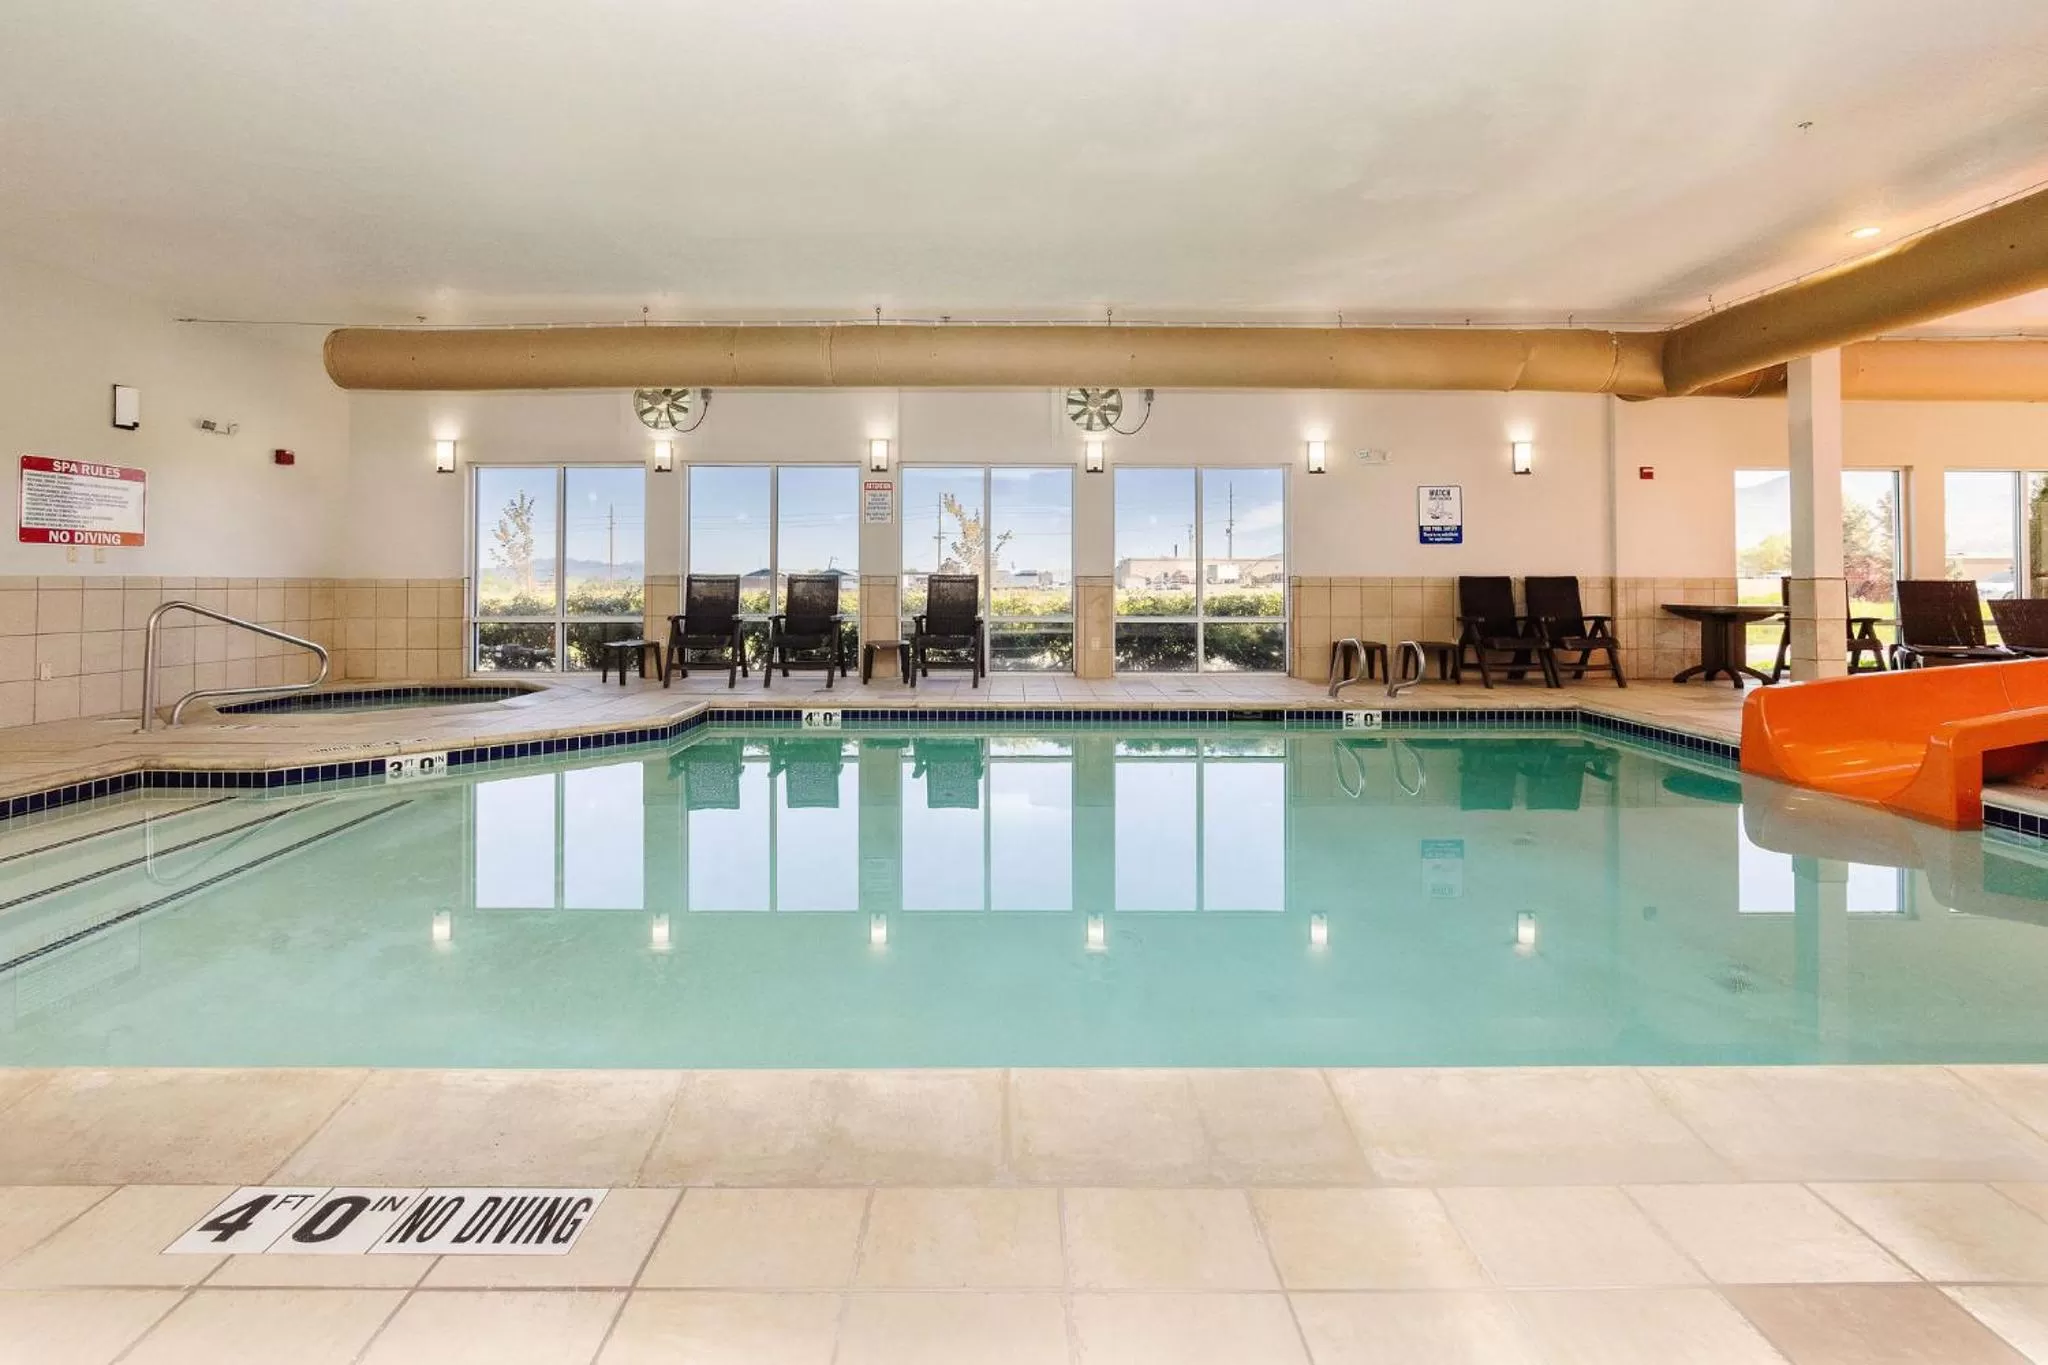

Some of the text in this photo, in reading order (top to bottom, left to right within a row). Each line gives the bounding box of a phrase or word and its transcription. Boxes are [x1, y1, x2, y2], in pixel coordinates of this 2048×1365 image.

[52, 460, 79, 474] SPA
[81, 464, 121, 478] RULES
[48, 530, 121, 545] NO DIVING
[389, 761, 403, 772] 3
[435, 755, 445, 763] IN
[196, 1194, 594, 1245] 4 FT 0 IN NO DIVING
